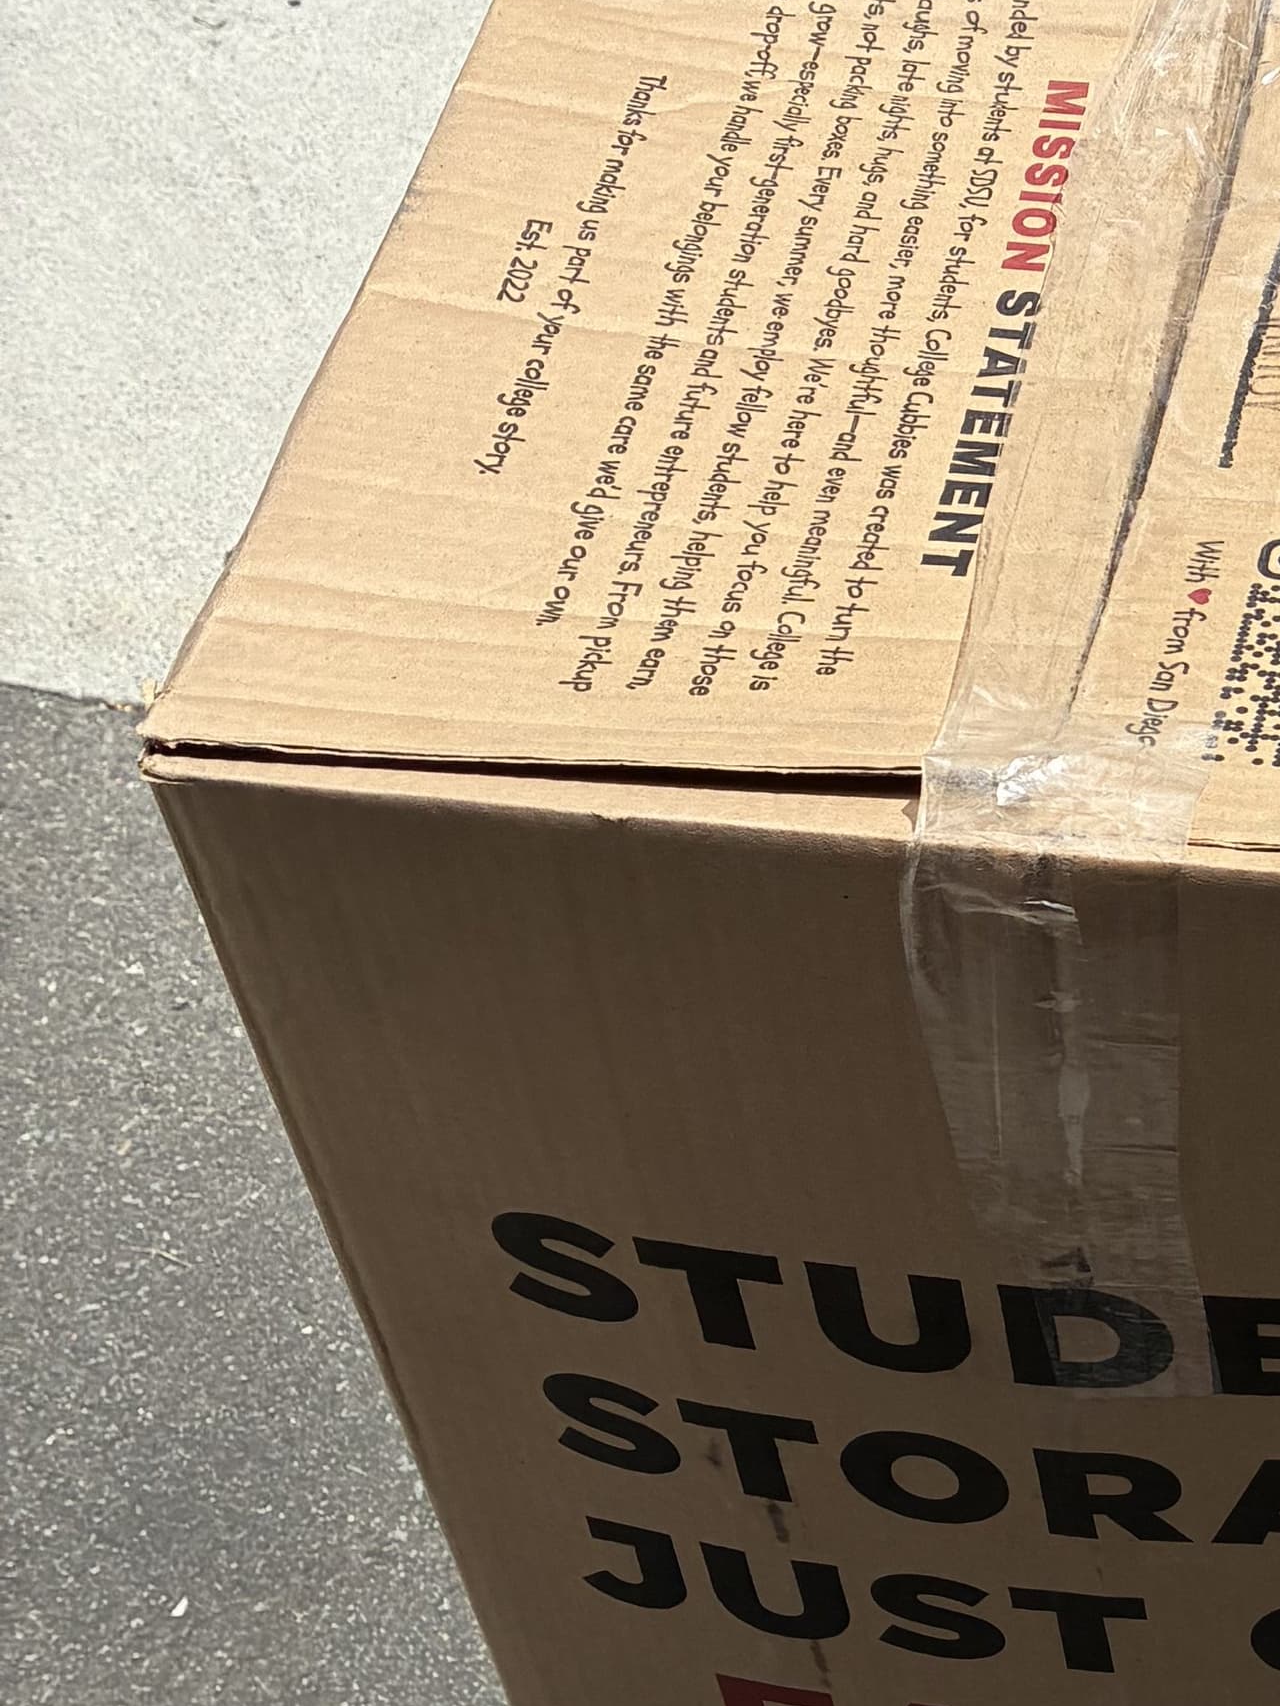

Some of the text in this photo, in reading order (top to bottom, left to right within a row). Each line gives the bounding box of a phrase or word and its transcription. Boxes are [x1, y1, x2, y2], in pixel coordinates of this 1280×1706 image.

[853, 21, 886, 54] not
[959, 8, 989, 35] of
[895, 58, 932, 93] late
[934, 34, 975, 94] moving
[992, 43, 1033, 69] by
[738, 79, 763, 102] we
[827, 54, 874, 110] packing
[718, 103, 764, 153] handle
[874, 93, 916, 142] nights,
[935, 96, 967, 128] into
[979, 70, 1024, 142] students
[819, 113, 864, 161] boxes.
[972, 145, 1004, 166] at
[702, 152, 735, 198] your
[796, 164, 843, 213] Every
[857, 145, 905, 187] hugs,
[898, 130, 949, 211] something
[956, 167, 999, 209] SDSU,
[851, 189, 884, 221] and
[951, 211, 989, 243] for
[494, 217, 554, 303] Est. 2022
[662, 199, 730, 284] belongings
[774, 213, 819, 287] summer,
[837, 222, 881, 264] hard
[887, 214, 924, 270] easier,
[471, 74, 668, 475] Thanks for making us part of your college story.
[876, 274, 907, 320] more
[923, 244, 976, 323] students,
[652, 287, 689, 327] with
[704, 267, 755, 346] students
[770, 292, 794, 320] we
[811, 264, 857, 352] goodbyes.
[918, 78, 1090, 577] MISSION STATEMENT
[642, 332, 682, 361] the
[688, 347, 724, 379] and
[738, 319, 785, 382] employ
[901, 327, 953, 387] College
[622, 362, 657, 412] same
[794, 356, 838, 405] We're
[668, 380, 719, 441] future
[724, 383, 774, 439] fellow
[779, 407, 823, 449] here
[886, 390, 935, 460] Cubbies
[605, 414, 637, 455] care
[584, 459, 623, 500] we'd
[690, 440, 750, 526] students,
[770, 451, 806, 476] to
[813, 465, 847, 504] even
[874, 463, 903, 500] was
[568, 499, 606, 541] give
[615, 443, 689, 576] entrepreneurs.
[745, 478, 799, 517] help
[657, 529, 724, 591] helping
[739, 518, 772, 556] you
[779, 508, 832, 605] meaningful.
[846, 503, 891, 571] created
[555, 543, 588, 582] our
[1182, 539, 1226, 584] With
[534, 584, 571, 627] own.
[594, 579, 644, 630] From
[719, 558, 769, 614] focus
[842, 575, 879, 600] to
[648, 594, 698, 643] them
[706, 619, 737, 639] on
[747, 609, 807, 671] College
[822, 601, 871, 642] turn
[1161, 605, 1208, 655] from
[556, 633, 614, 693] pickup
[623, 646, 666, 691] earn,
[686, 642, 738, 697] those
[747, 673, 779, 692] is
[813, 644, 855, 676] the
[1147, 659, 1191, 692] San
[582, 1516, 1148, 1676] JUST
